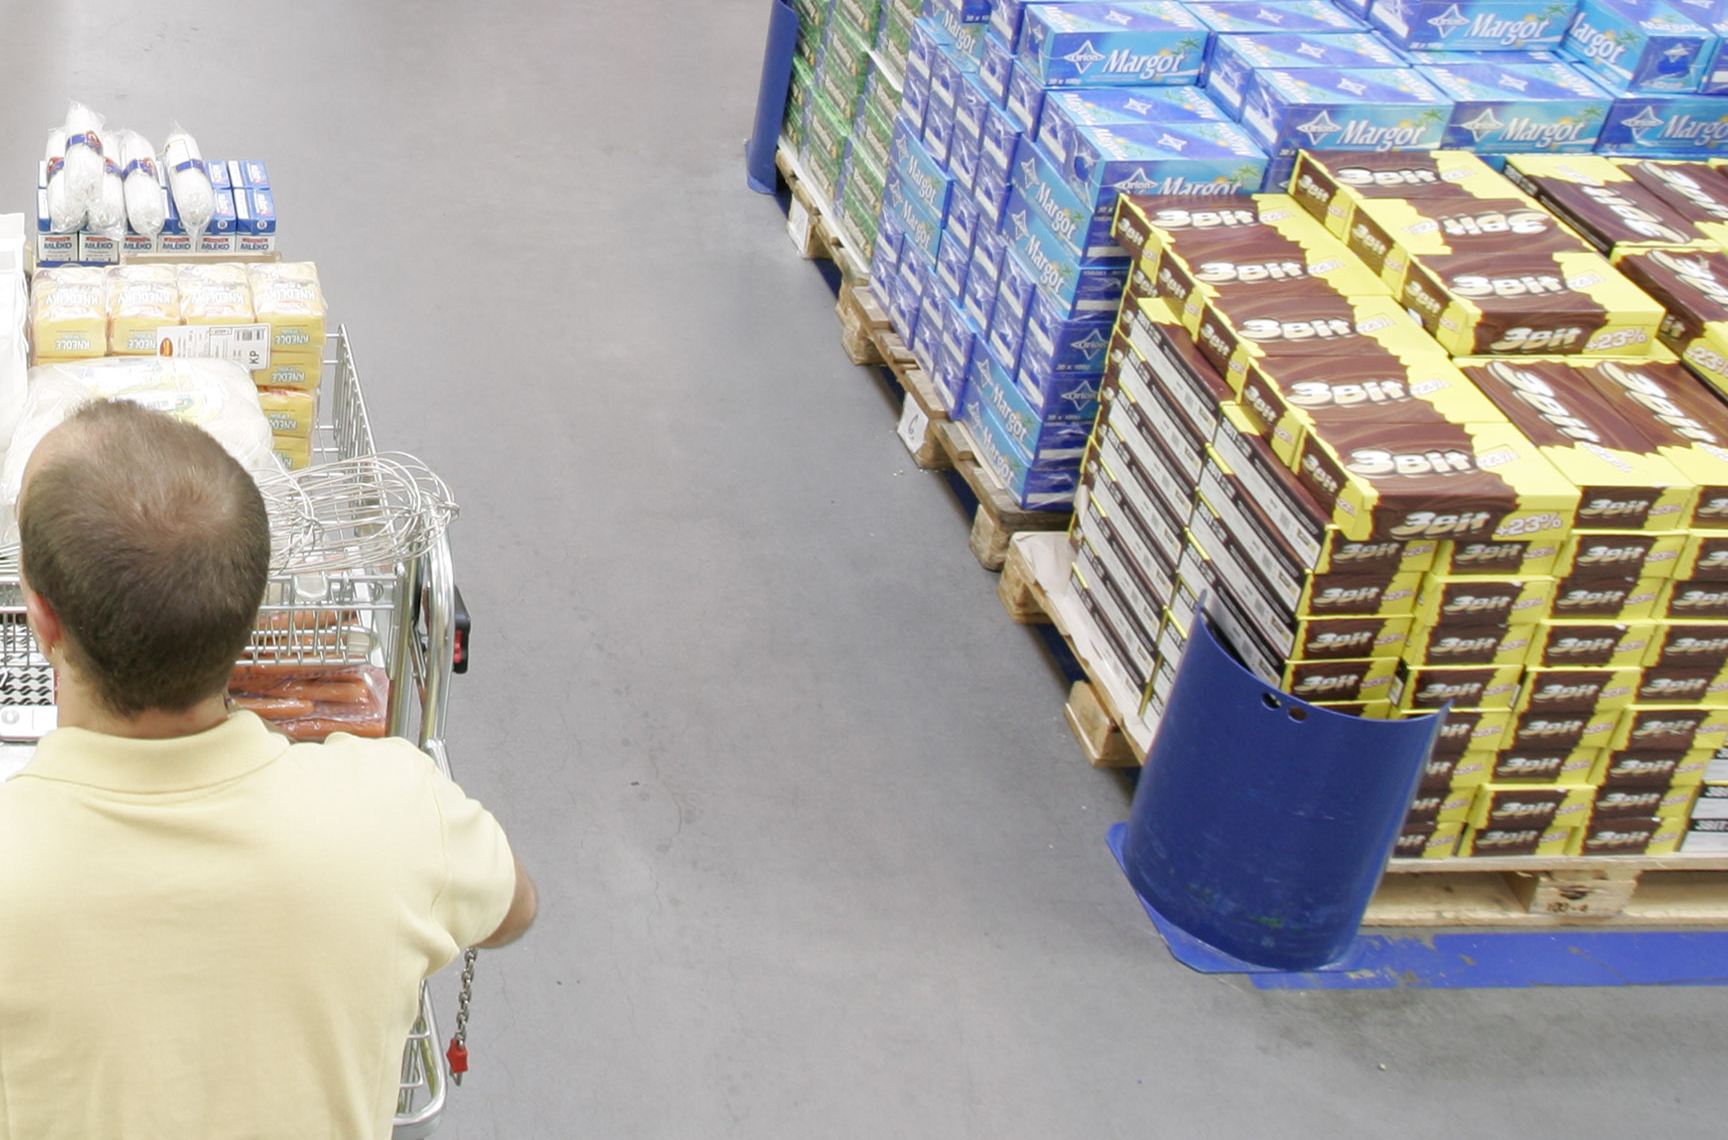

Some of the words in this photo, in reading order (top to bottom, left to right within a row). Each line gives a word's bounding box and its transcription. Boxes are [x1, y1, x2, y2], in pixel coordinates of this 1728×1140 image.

[1464, 13, 1550, 46] Margot
[1068, 51, 1104, 64] Orion
[1101, 49, 1186, 81] Margot
[1336, 118, 1428, 153] Margot
[1499, 116, 1589, 150] Margot
[906, 155, 938, 207] Margot
[901, 200, 932, 251] Margot
[1035, 179, 1078, 238] Margot
[1026, 234, 1066, 291] Margot
[1584, 325, 1649, 351] +23%
[248, 350, 260, 365] KP
[989, 380, 1029, 443] Margot
[1494, 512, 1563, 537] +23%
